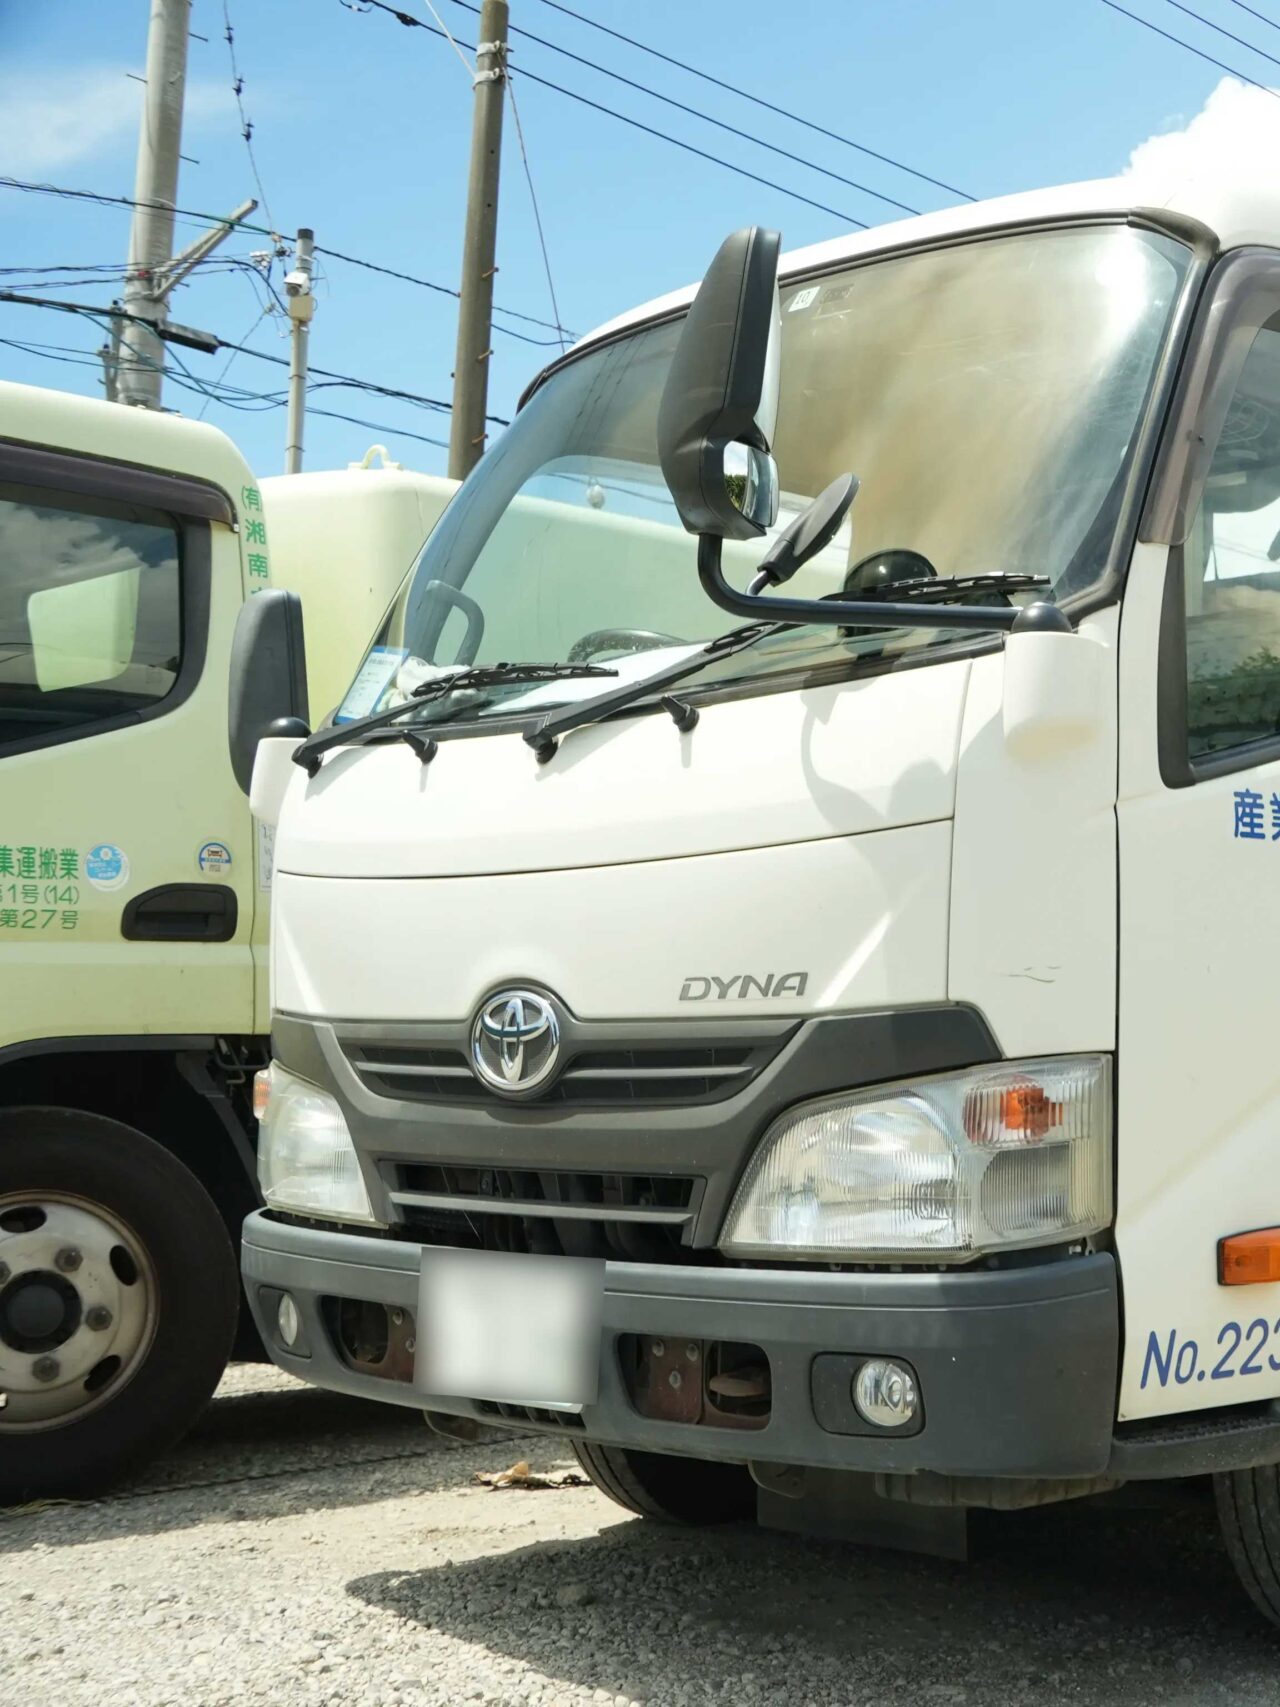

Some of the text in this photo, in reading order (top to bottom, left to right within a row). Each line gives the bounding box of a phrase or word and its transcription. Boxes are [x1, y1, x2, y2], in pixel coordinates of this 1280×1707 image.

[241, 485, 269, 594] (有)湘南
[0, 884, 80, 905] 1号(14)
[679, 972, 808, 1001] DYNA
